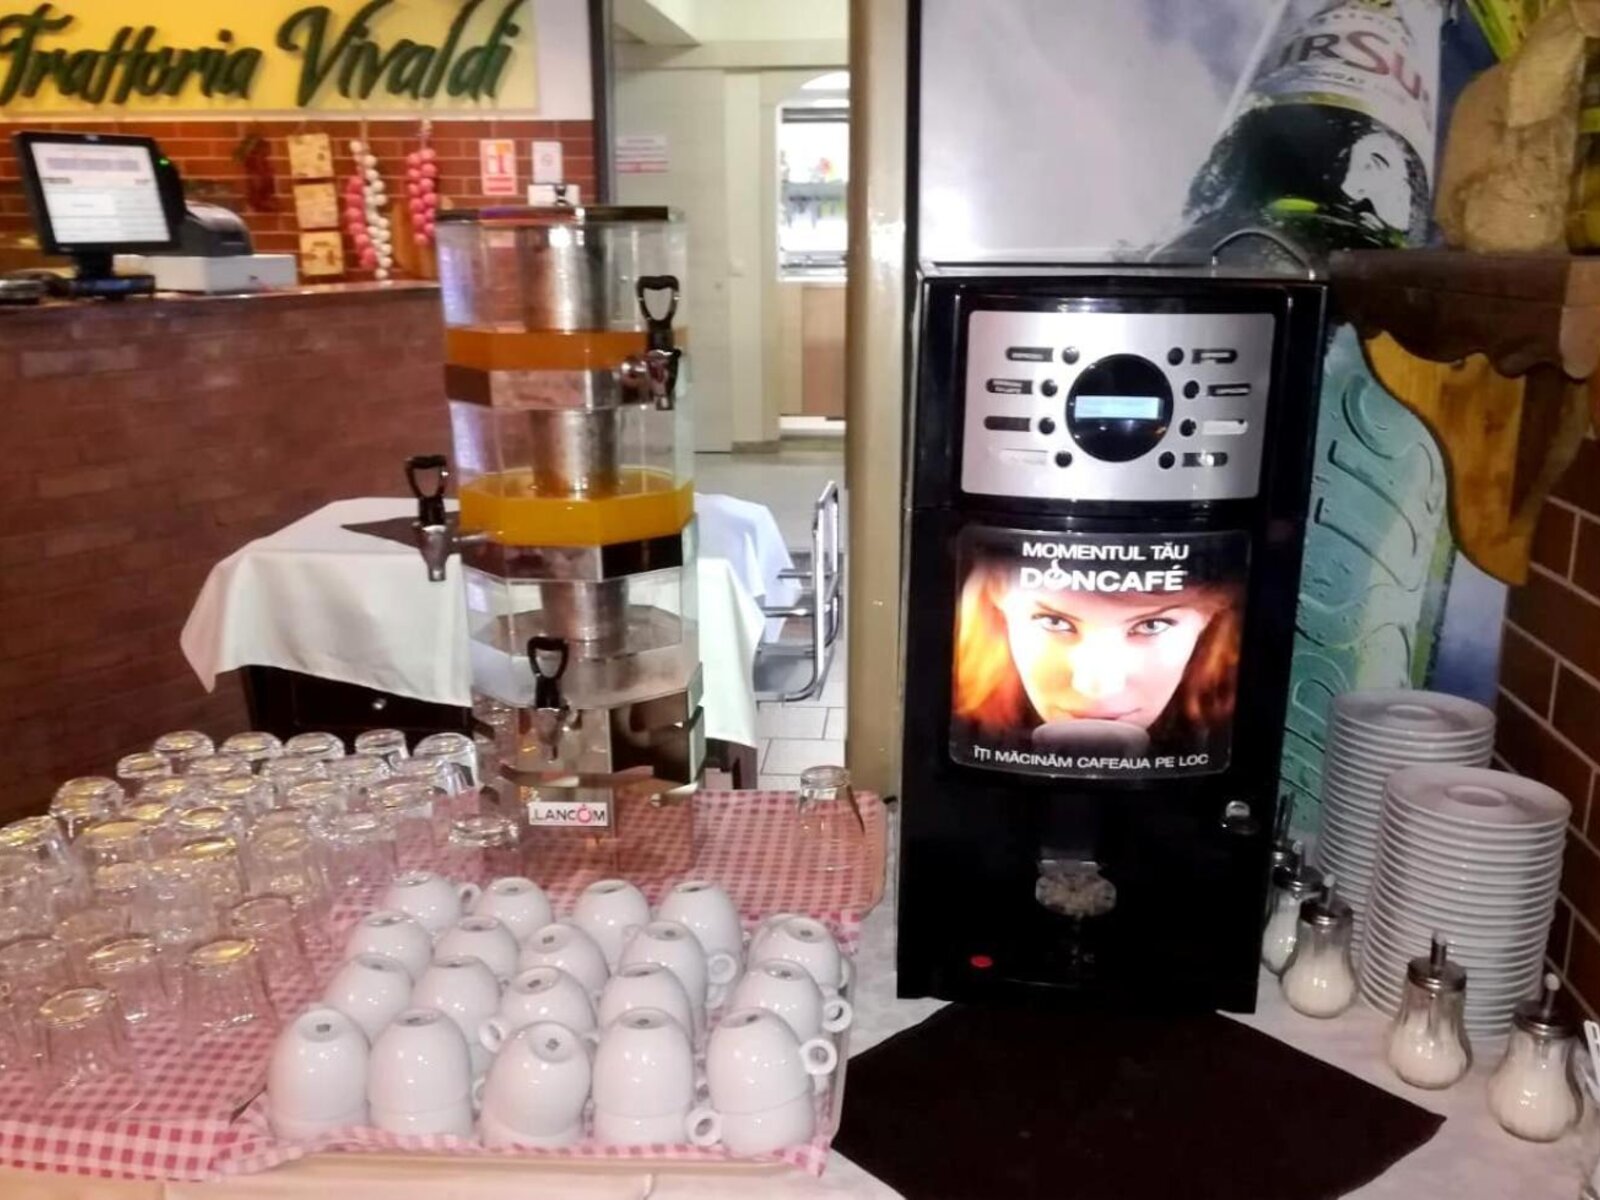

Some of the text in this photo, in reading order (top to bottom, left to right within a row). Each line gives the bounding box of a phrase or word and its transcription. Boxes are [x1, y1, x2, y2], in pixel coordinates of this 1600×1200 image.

[0, 0, 521, 107] Trattoria Vivaldi
[1274, 30, 1430, 101] RSU
[1022, 541, 1190, 561] MOMENTUL TĂU
[1019, 560, 1188, 592] DONCAFÉ
[994, 750, 1073, 768] MĂCINĂM
[1076, 756, 1151, 770] CAFEAUA
[1154, 756, 1175, 769] PE
[1178, 753, 1209, 767] LOC
[534, 804, 605, 823] LANCOM
